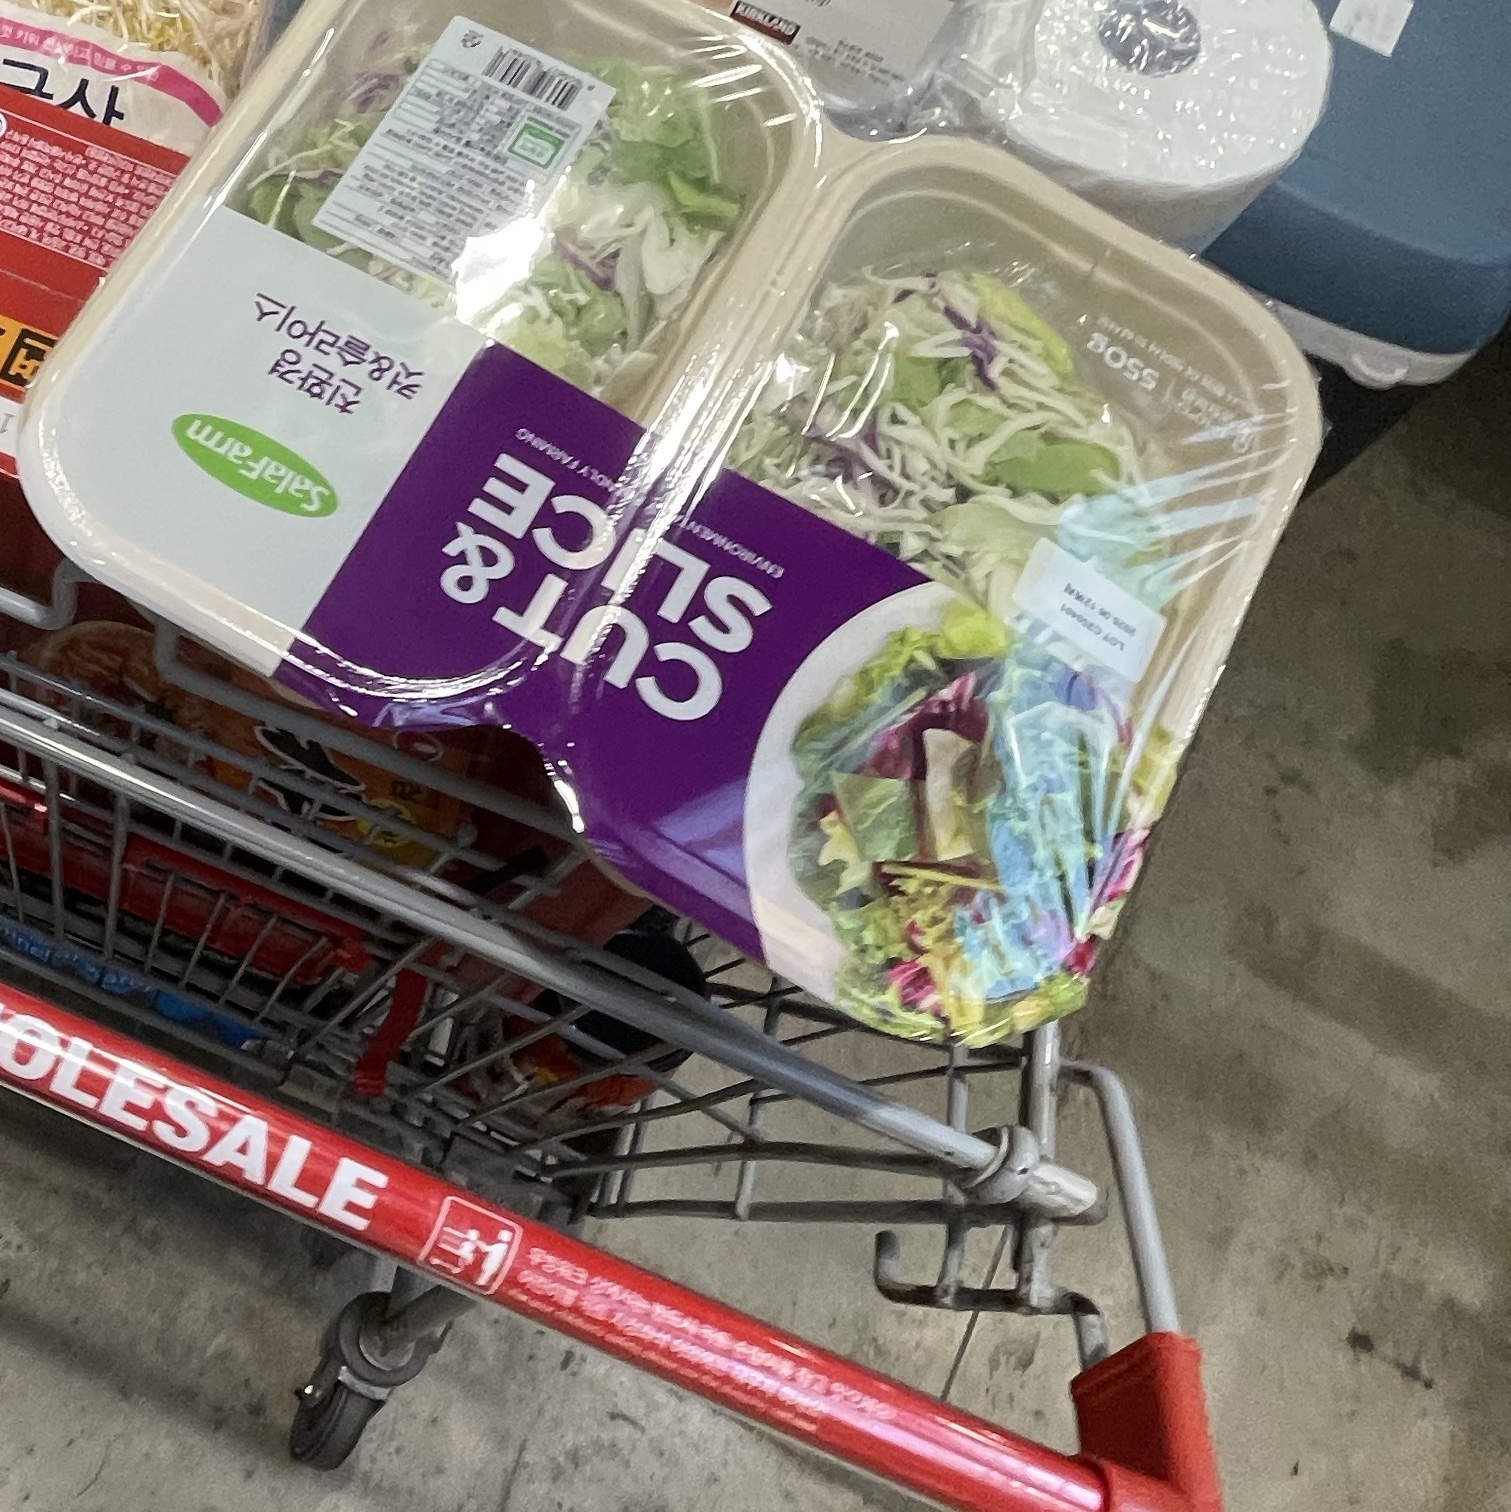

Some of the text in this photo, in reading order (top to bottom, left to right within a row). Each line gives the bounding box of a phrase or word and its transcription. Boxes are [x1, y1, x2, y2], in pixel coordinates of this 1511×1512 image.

[255, 293, 424, 399] 컷&슬라이스
[269, 348, 363, 414] 친환경
[1085, 331, 1159, 391] 550g
[186, 419, 330, 512] SalaFarm
[468, 453, 772, 653] SLICE
[440, 521, 723, 721] CUT &
